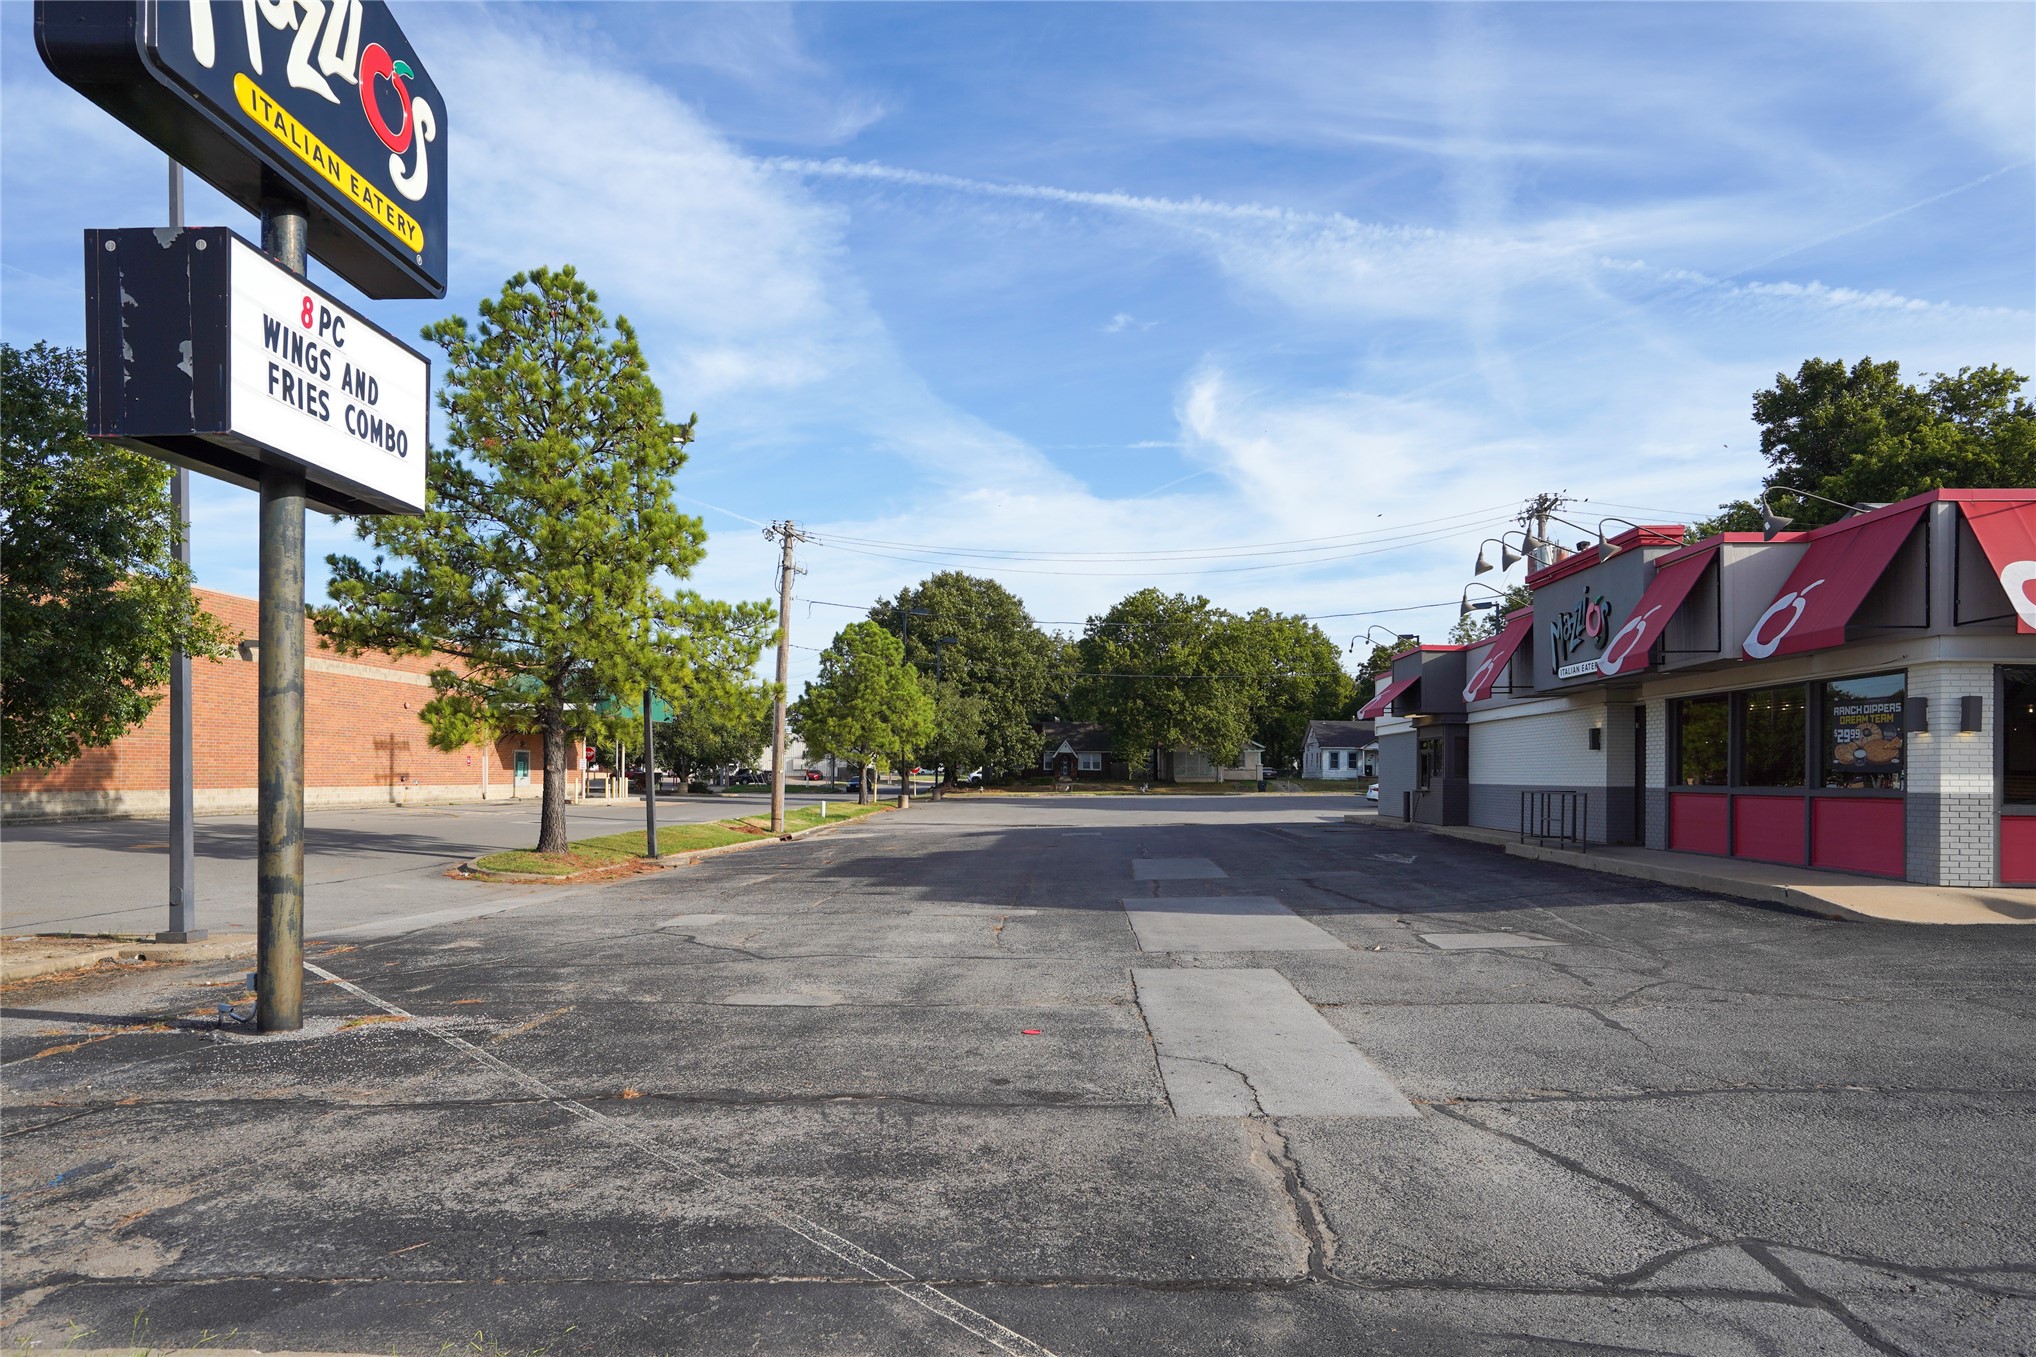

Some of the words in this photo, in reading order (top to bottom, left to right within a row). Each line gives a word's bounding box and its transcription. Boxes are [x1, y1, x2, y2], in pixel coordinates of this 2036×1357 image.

[251, 88, 341, 181] ITALIAN
[350, 171, 416, 241] EATERY
[301, 296, 314, 329] 8
[319, 305, 345, 348] PC
[263, 313, 331, 381] WINGS
[341, 362, 379, 406] AND
[268, 361, 330, 422] FRIES
[345, 404, 408, 458] COMBO
[1560, 666, 1580, 677] ITALIAN
[1582, 662, 1598, 672] EATER
[1833, 705, 1862, 716] RANCH
[1863, 703, 1901, 714] DIPPERS
[1840, 715, 1868, 724] DREAM
[1870, 713, 1894, 723] TEAM
